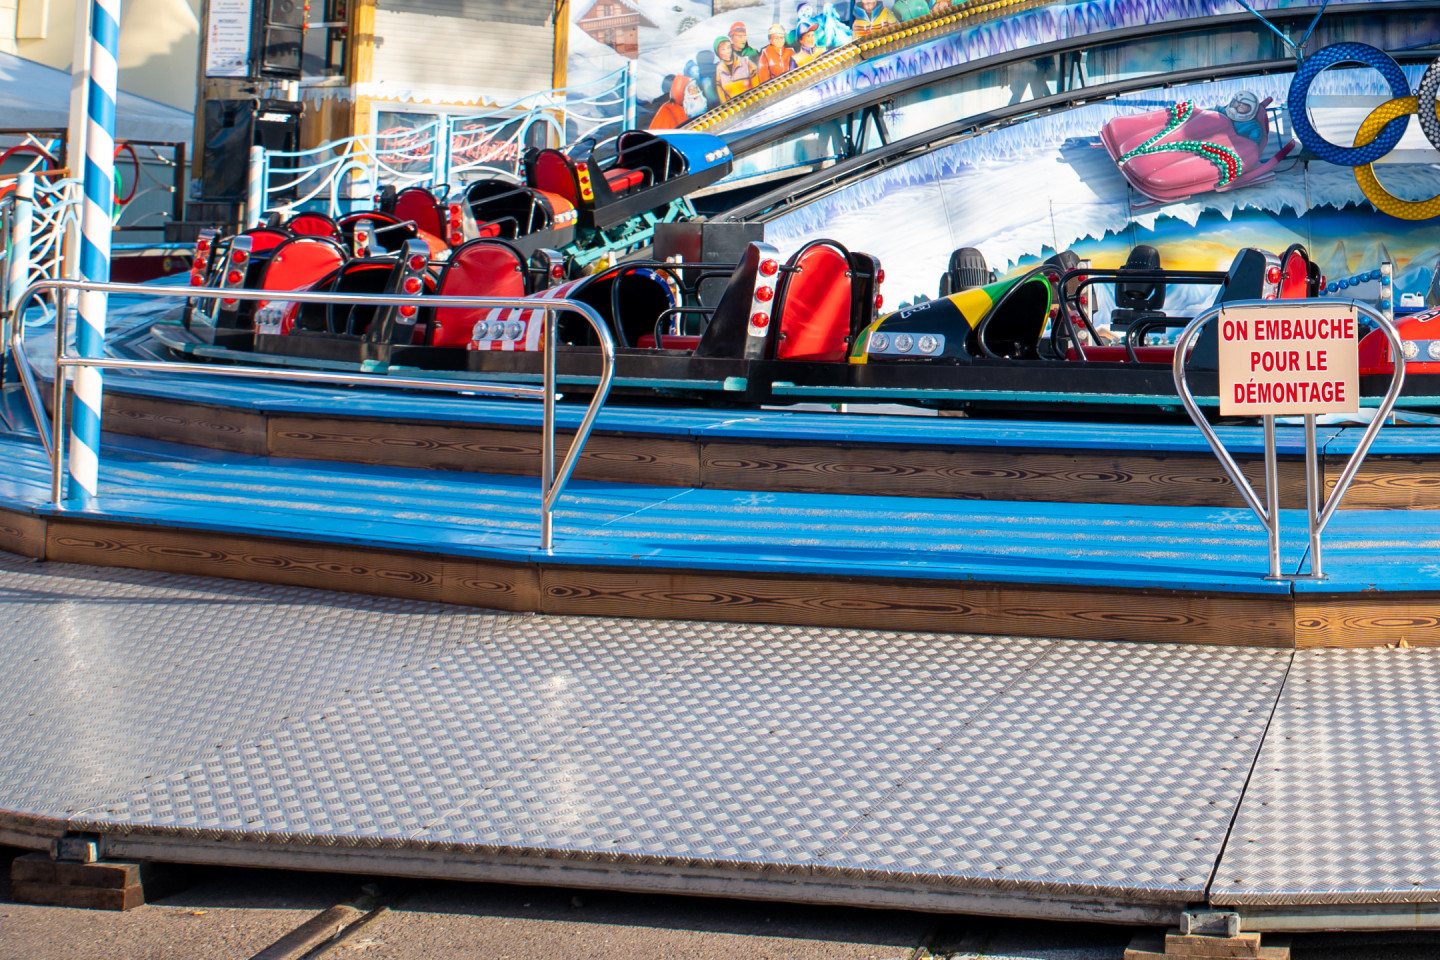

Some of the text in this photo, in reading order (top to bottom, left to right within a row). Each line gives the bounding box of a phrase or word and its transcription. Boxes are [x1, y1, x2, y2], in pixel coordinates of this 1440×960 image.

[1222, 318, 1354, 341] ON EMBAUCHE
[1250, 350, 1327, 372] POUR LE
[1233, 377, 1346, 404] DÉMONTAGE
